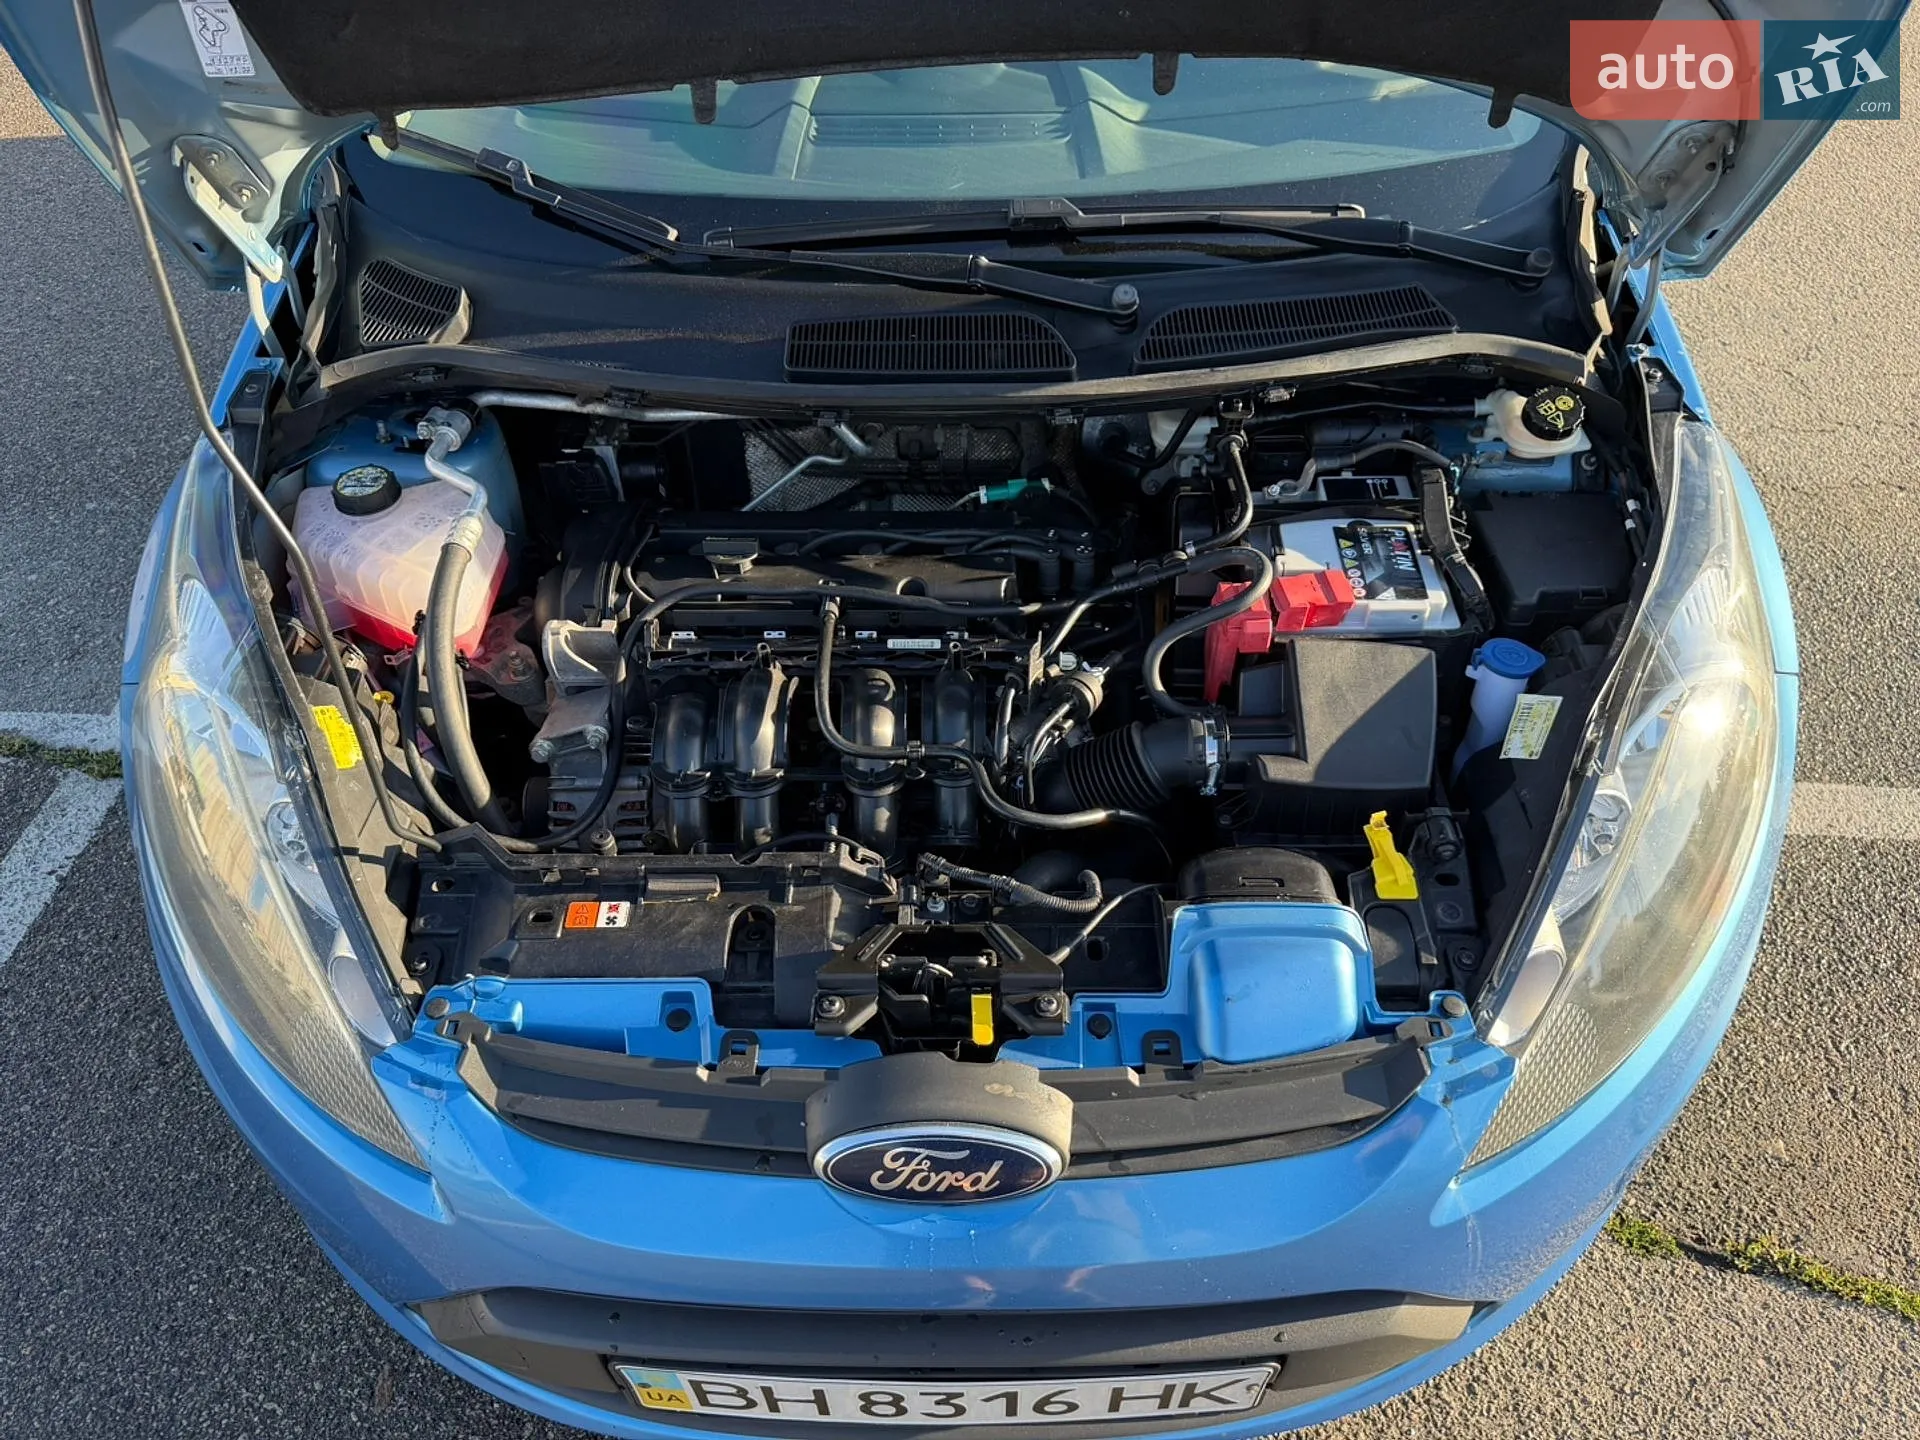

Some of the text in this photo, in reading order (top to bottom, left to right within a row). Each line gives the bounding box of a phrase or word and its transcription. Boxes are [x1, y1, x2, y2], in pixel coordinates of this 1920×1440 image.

[1388, 529, 1416, 571] PLATIN
[869, 1146, 1004, 1192] Ford
[647, 1377, 1250, 1419] UA BH 8316 HK
